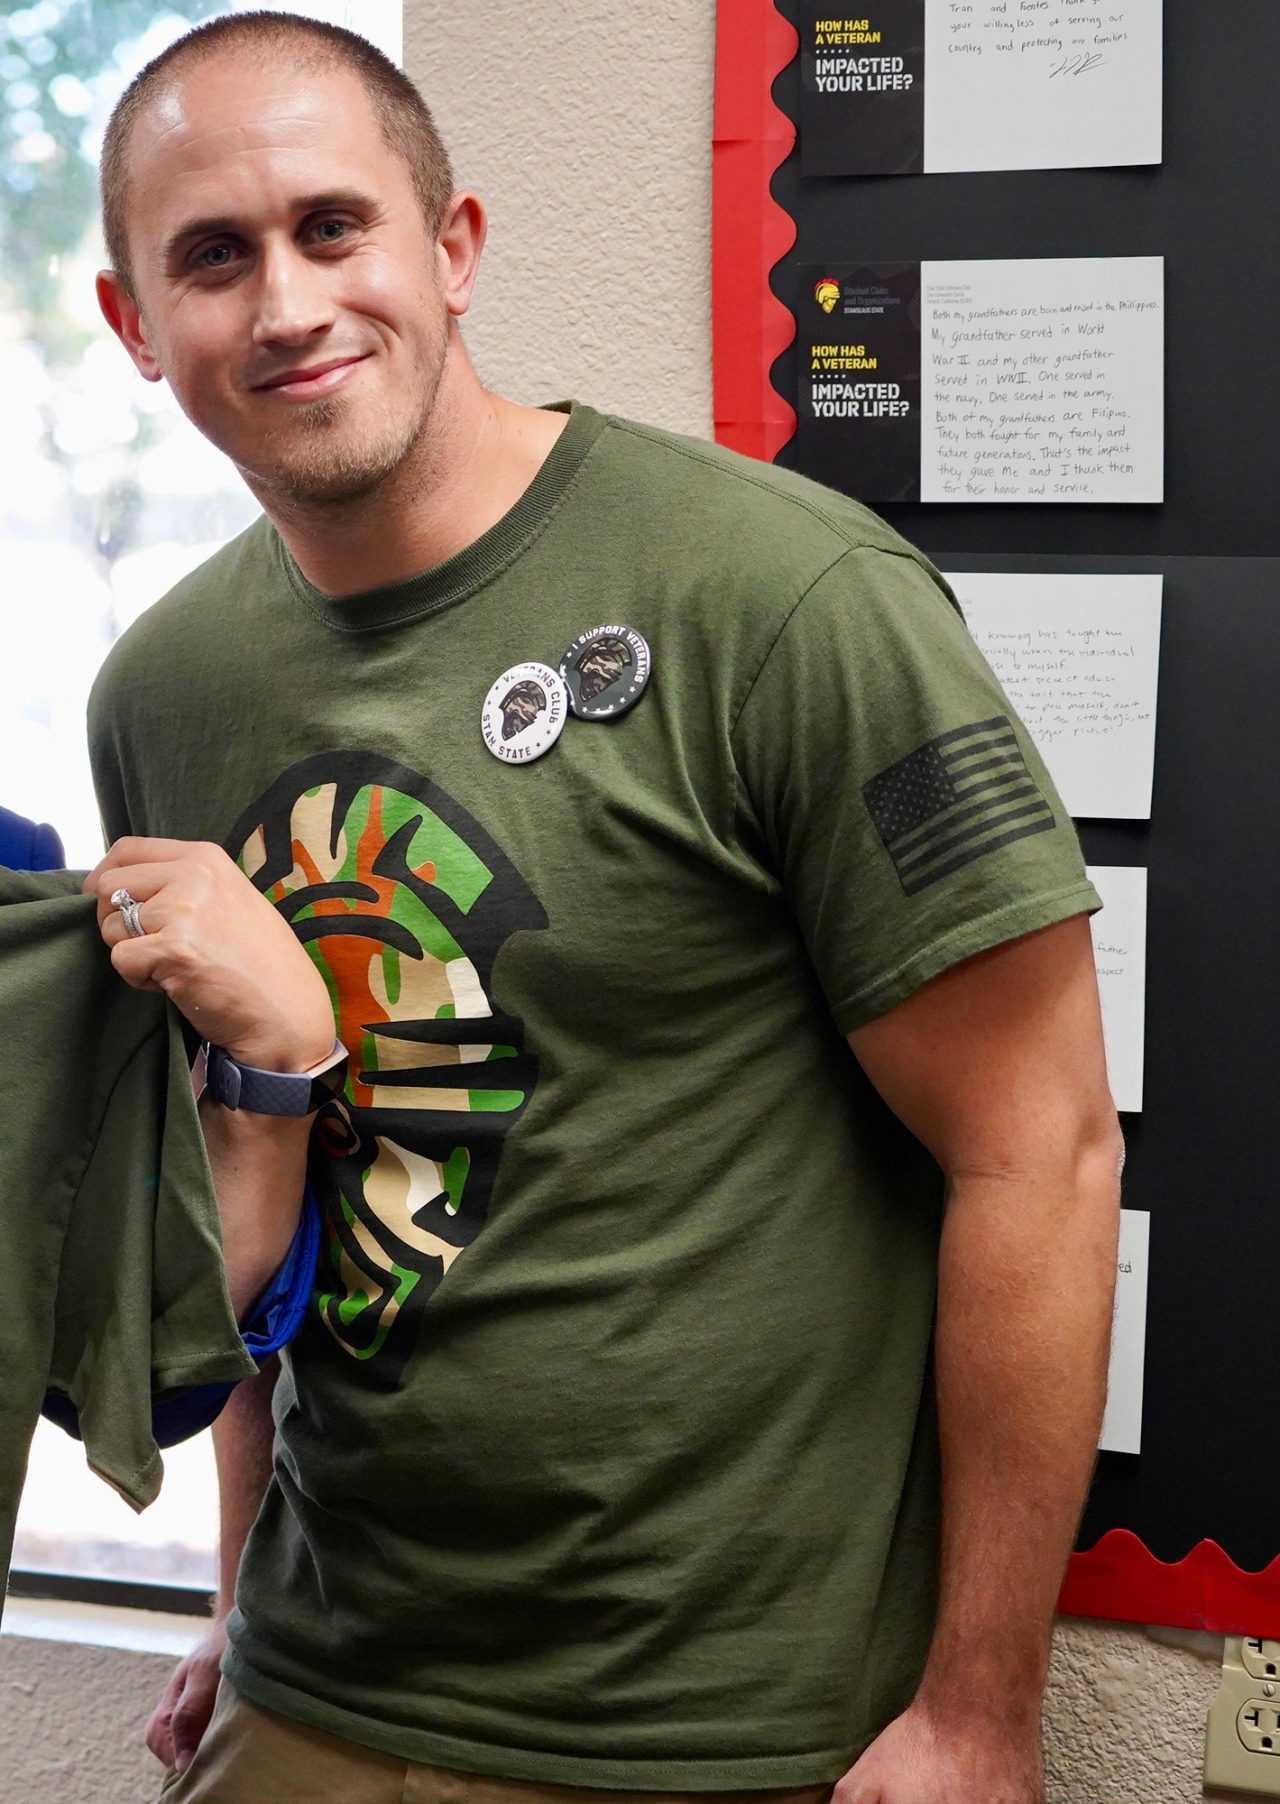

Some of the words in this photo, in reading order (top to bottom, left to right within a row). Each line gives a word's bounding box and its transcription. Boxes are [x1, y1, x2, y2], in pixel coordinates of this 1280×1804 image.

[949, 3, 973, 13] Tran
[990, 1, 1007, 13] and
[815, 20, 842, 32] HOW
[844, 19, 869, 31] HAS
[949, 21, 972, 33] your
[1067, 16, 1103, 29] serving
[815, 33, 824, 45] A
[826, 31, 881, 44] VETERAN
[996, 39, 1014, 51] and
[815, 57, 904, 75] IMPACTED
[815, 76, 863, 92] YOUR
[866, 73, 913, 91] LIFE?
[1021, 307, 1039, 317] are
[932, 327, 945, 347] My
[950, 327, 1017, 349] grandfather
[1020, 324, 1053, 340] served
[1077, 322, 1105, 336] World
[811, 345, 838, 357] HOW
[841, 345, 865, 356] HAS
[932, 352, 954, 366] War
[977, 351, 999, 366] and
[1003, 356, 1018, 371] my
[1022, 352, 1049, 366] other
[1053, 348, 1117, 369] grandfather
[811, 358, 821, 370] A
[822, 358, 877, 369] VETERAN
[976, 373, 988, 385] in
[1038, 370, 1059, 382] One
[1064, 368, 1093, 381] served
[811, 383, 901, 400] IMPACTED
[934, 390, 950, 402] the
[988, 390, 1008, 403] One
[1014, 388, 1045, 402] served
[1063, 389, 1080, 399] the
[811, 401, 860, 418] YOUR
[863, 401, 910, 417] LIFE?
[962, 410, 977, 421] of
[979, 413, 993, 429] my
[1000, 411, 1055, 428] grandfathers
[1062, 411, 1084, 422] are
[936, 425, 960, 442] They
[965, 427, 986, 441] both
[989, 428, 1019, 444] fought
[1022, 426, 1041, 440] for
[1048, 430, 1063, 444] my
[1066, 426, 1103, 443] family
[1106, 423, 1126, 438] and
[936, 445, 969, 459] future
[1040, 446, 1072, 459] That's
[1076, 444, 1093, 457] the
[1097, 441, 1131, 457] impact
[937, 462, 962, 480] they
[970, 465, 995, 482] gave
[1028, 463, 1051, 477] and
[1060, 463, 1070, 477] I
[1074, 462, 1105, 474] thank
[993, 480, 1020, 495] honor
[1027, 483, 1046, 496] and
[578, 625, 626, 644] SUPPORT
[626, 631, 647, 684] VETERANS
[548, 691, 561, 724] CLUB
[482, 714, 497, 748] STAN
[497, 745, 532, 759] STATE
